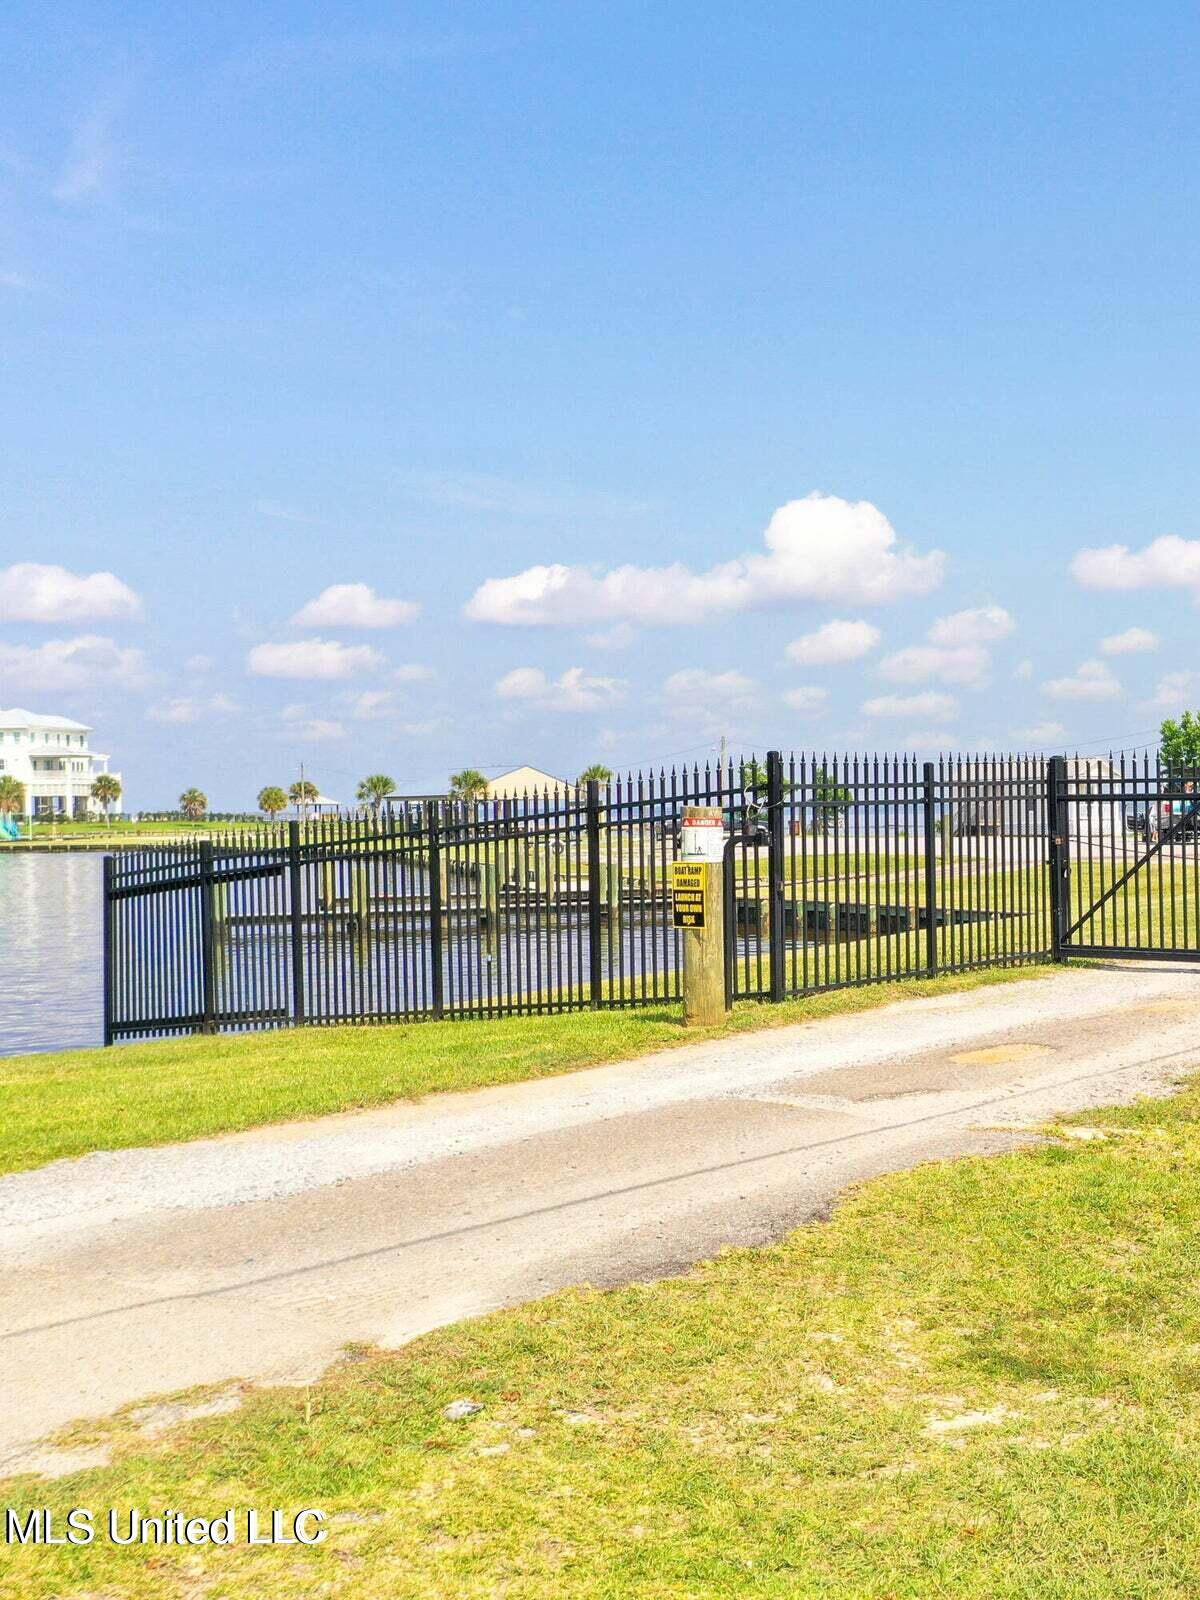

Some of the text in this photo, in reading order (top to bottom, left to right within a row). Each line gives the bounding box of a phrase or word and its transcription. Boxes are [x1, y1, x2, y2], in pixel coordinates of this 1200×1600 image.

[675, 866, 702, 875] BOAT RAMP
[677, 879, 700, 887] DAMAGED
[675, 893, 702, 901] LAUNCH AT
[676, 904, 702, 912] YOUR OWN
[682, 915, 695, 923] RISK
